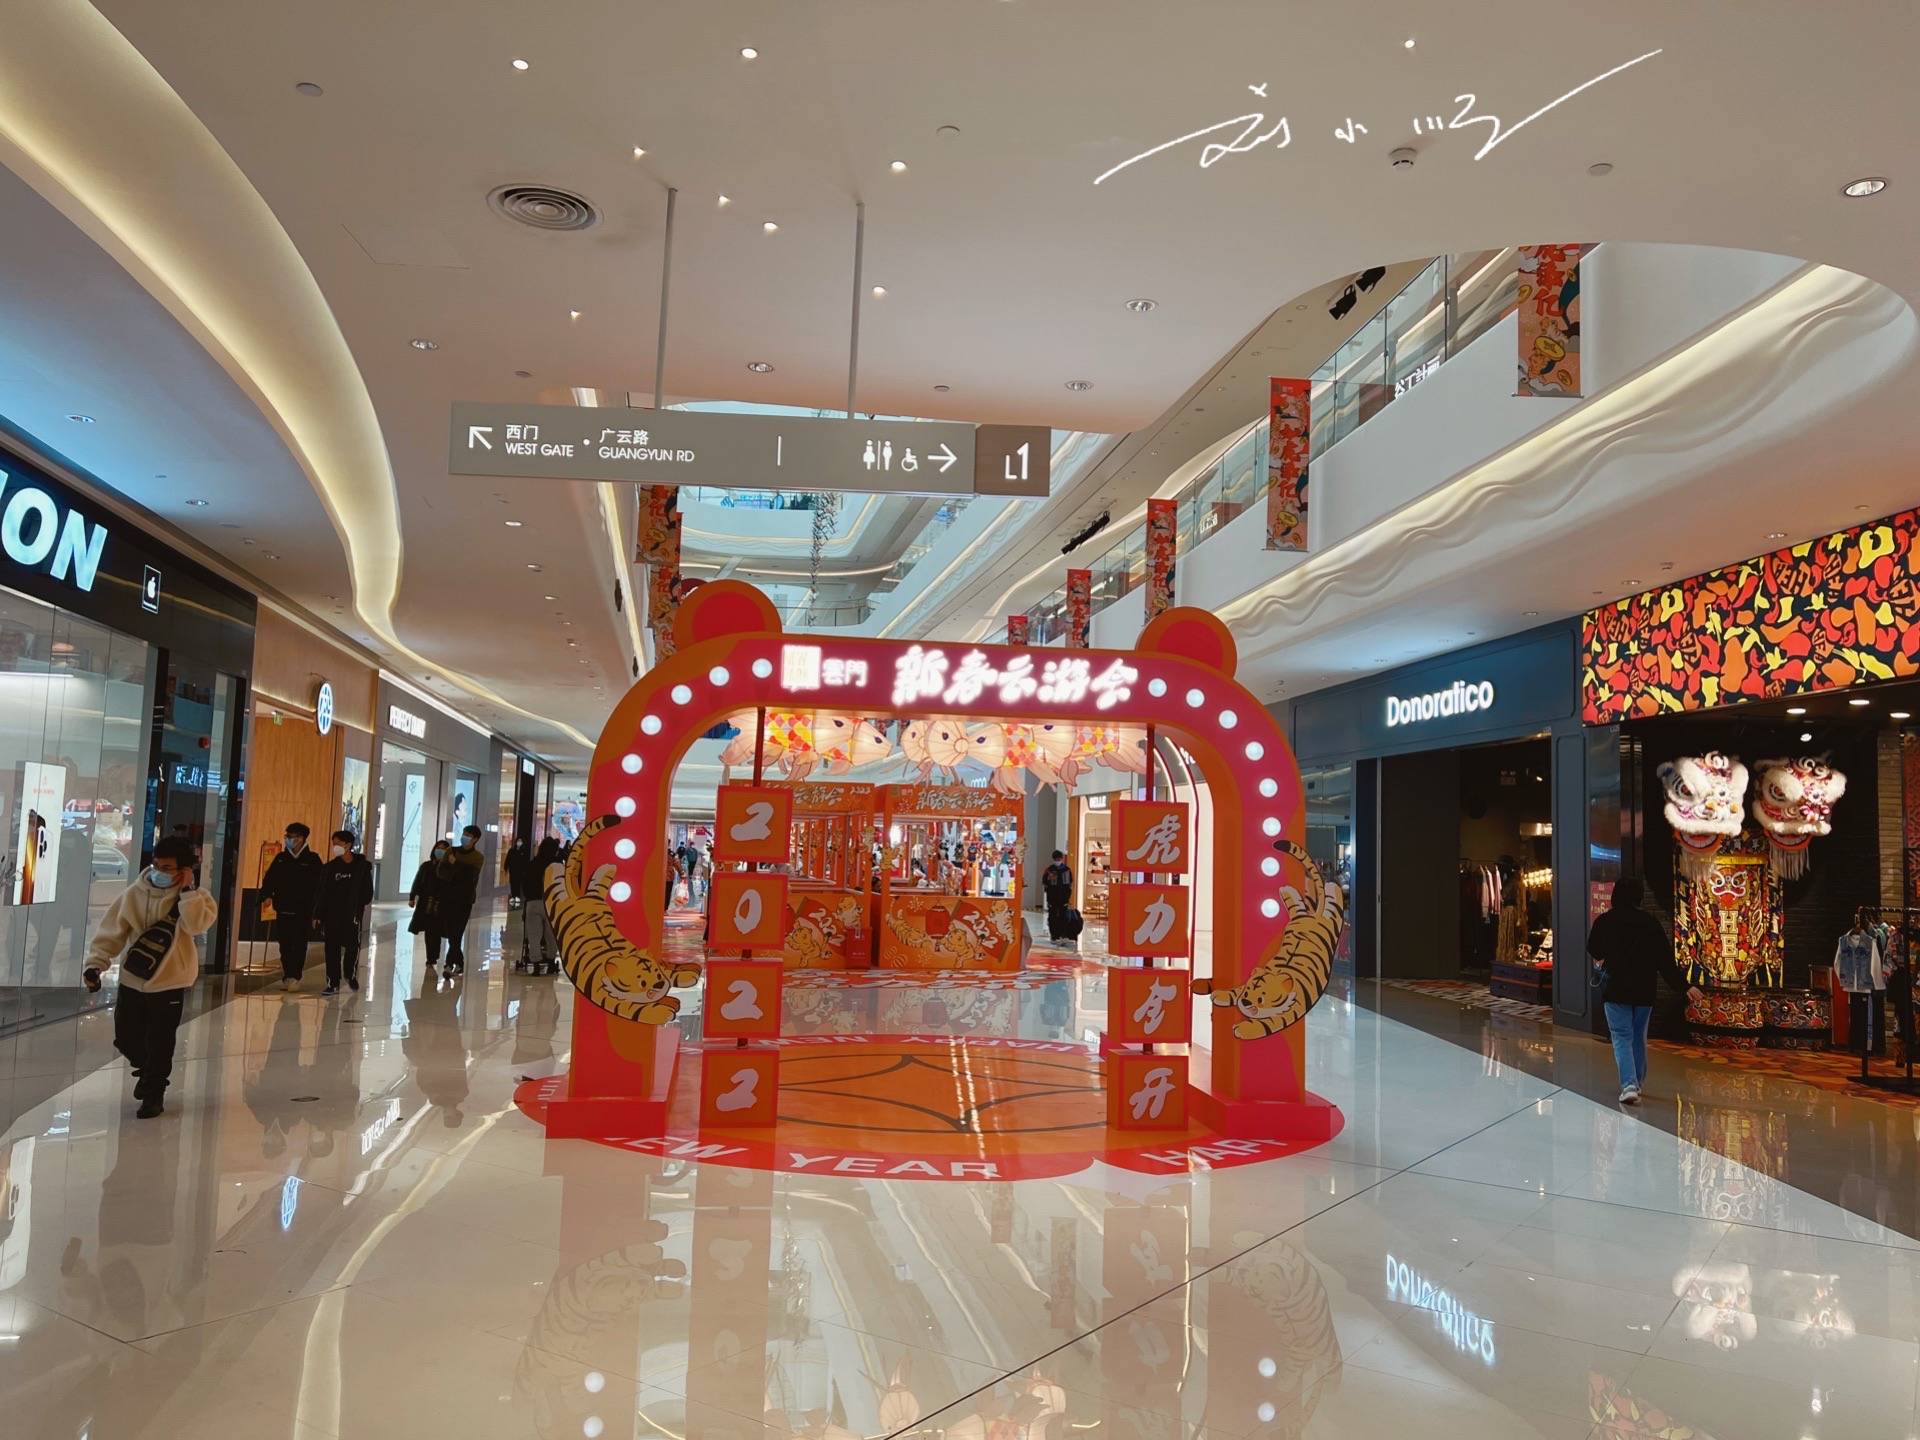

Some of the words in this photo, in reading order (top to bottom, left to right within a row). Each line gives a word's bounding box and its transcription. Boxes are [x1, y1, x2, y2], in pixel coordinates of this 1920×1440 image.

[505, 424, 538, 440] 西门
[598, 428, 649, 445] 广云路
[505, 442, 537, 456] WEST
[540, 443, 574, 457] GATE
[598, 446, 673, 461] GUANGYUN
[676, 449, 695, 462] RD
[1004, 443, 1030, 481] L1
[0, 469, 109, 592] ON
[891, 645, 1139, 711] 新春云游会
[1386, 680, 1495, 727] Donoratico
[788, 1153, 1002, 1177] YEAR
